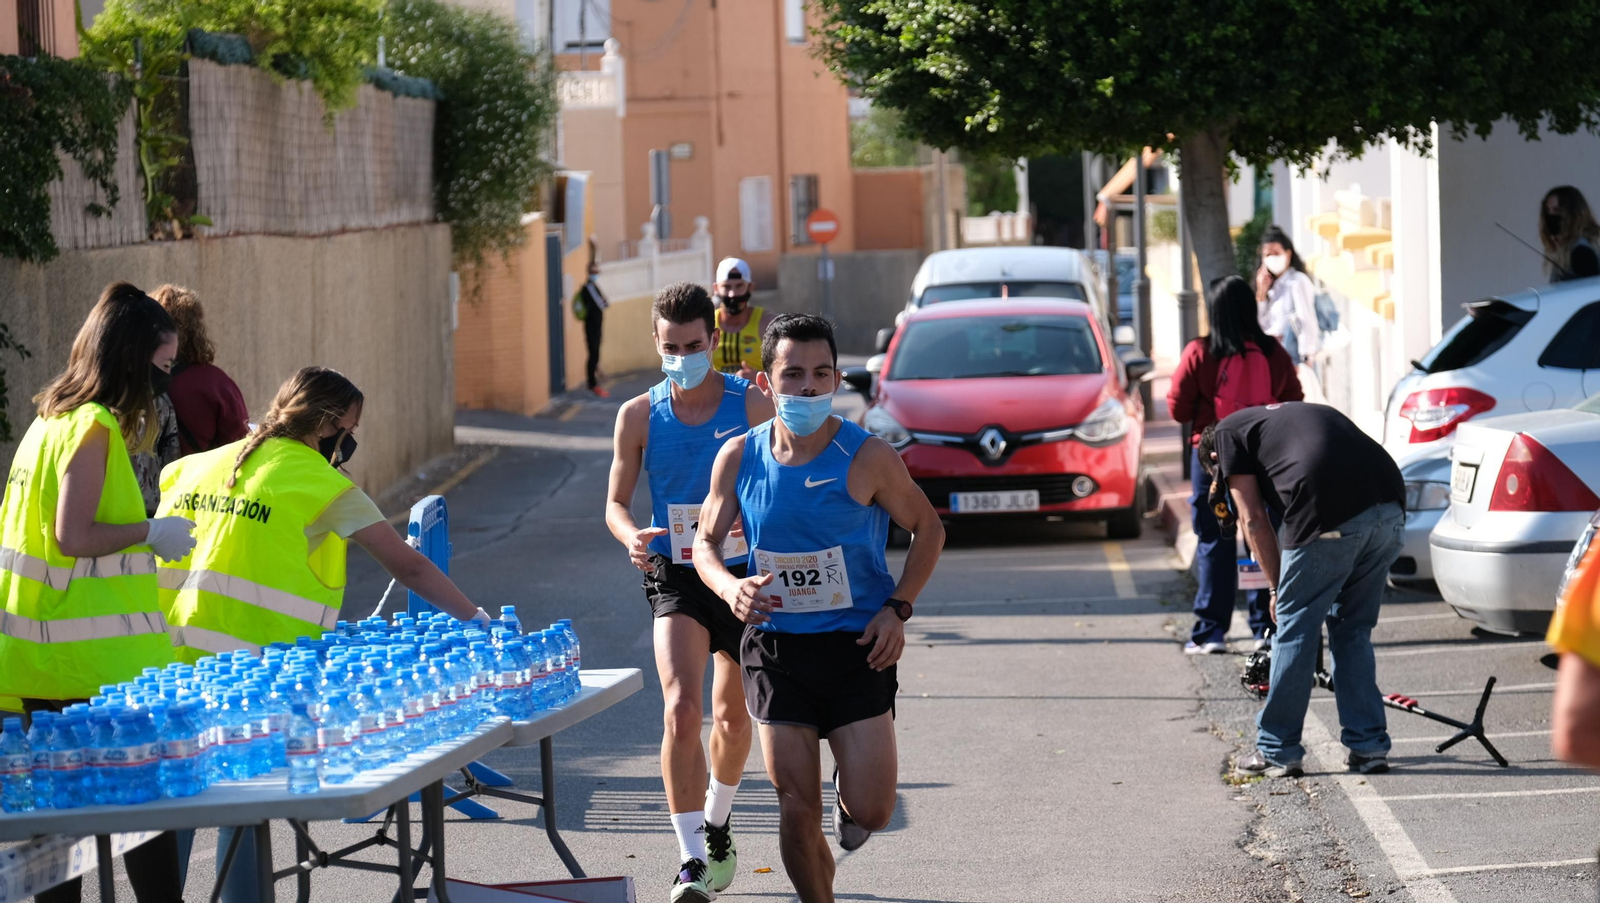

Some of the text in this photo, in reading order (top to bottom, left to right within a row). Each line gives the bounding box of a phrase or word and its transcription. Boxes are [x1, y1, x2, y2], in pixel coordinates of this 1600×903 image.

[174, 493, 271, 523] ORGANIZACIÓN
[963, 493, 1035, 510] 1380 JLG
[774, 556, 800, 564] CIRCUITO
[801, 555, 818, 564] 2020
[779, 569, 822, 587] 192
[789, 587, 817, 597] JUANGA
